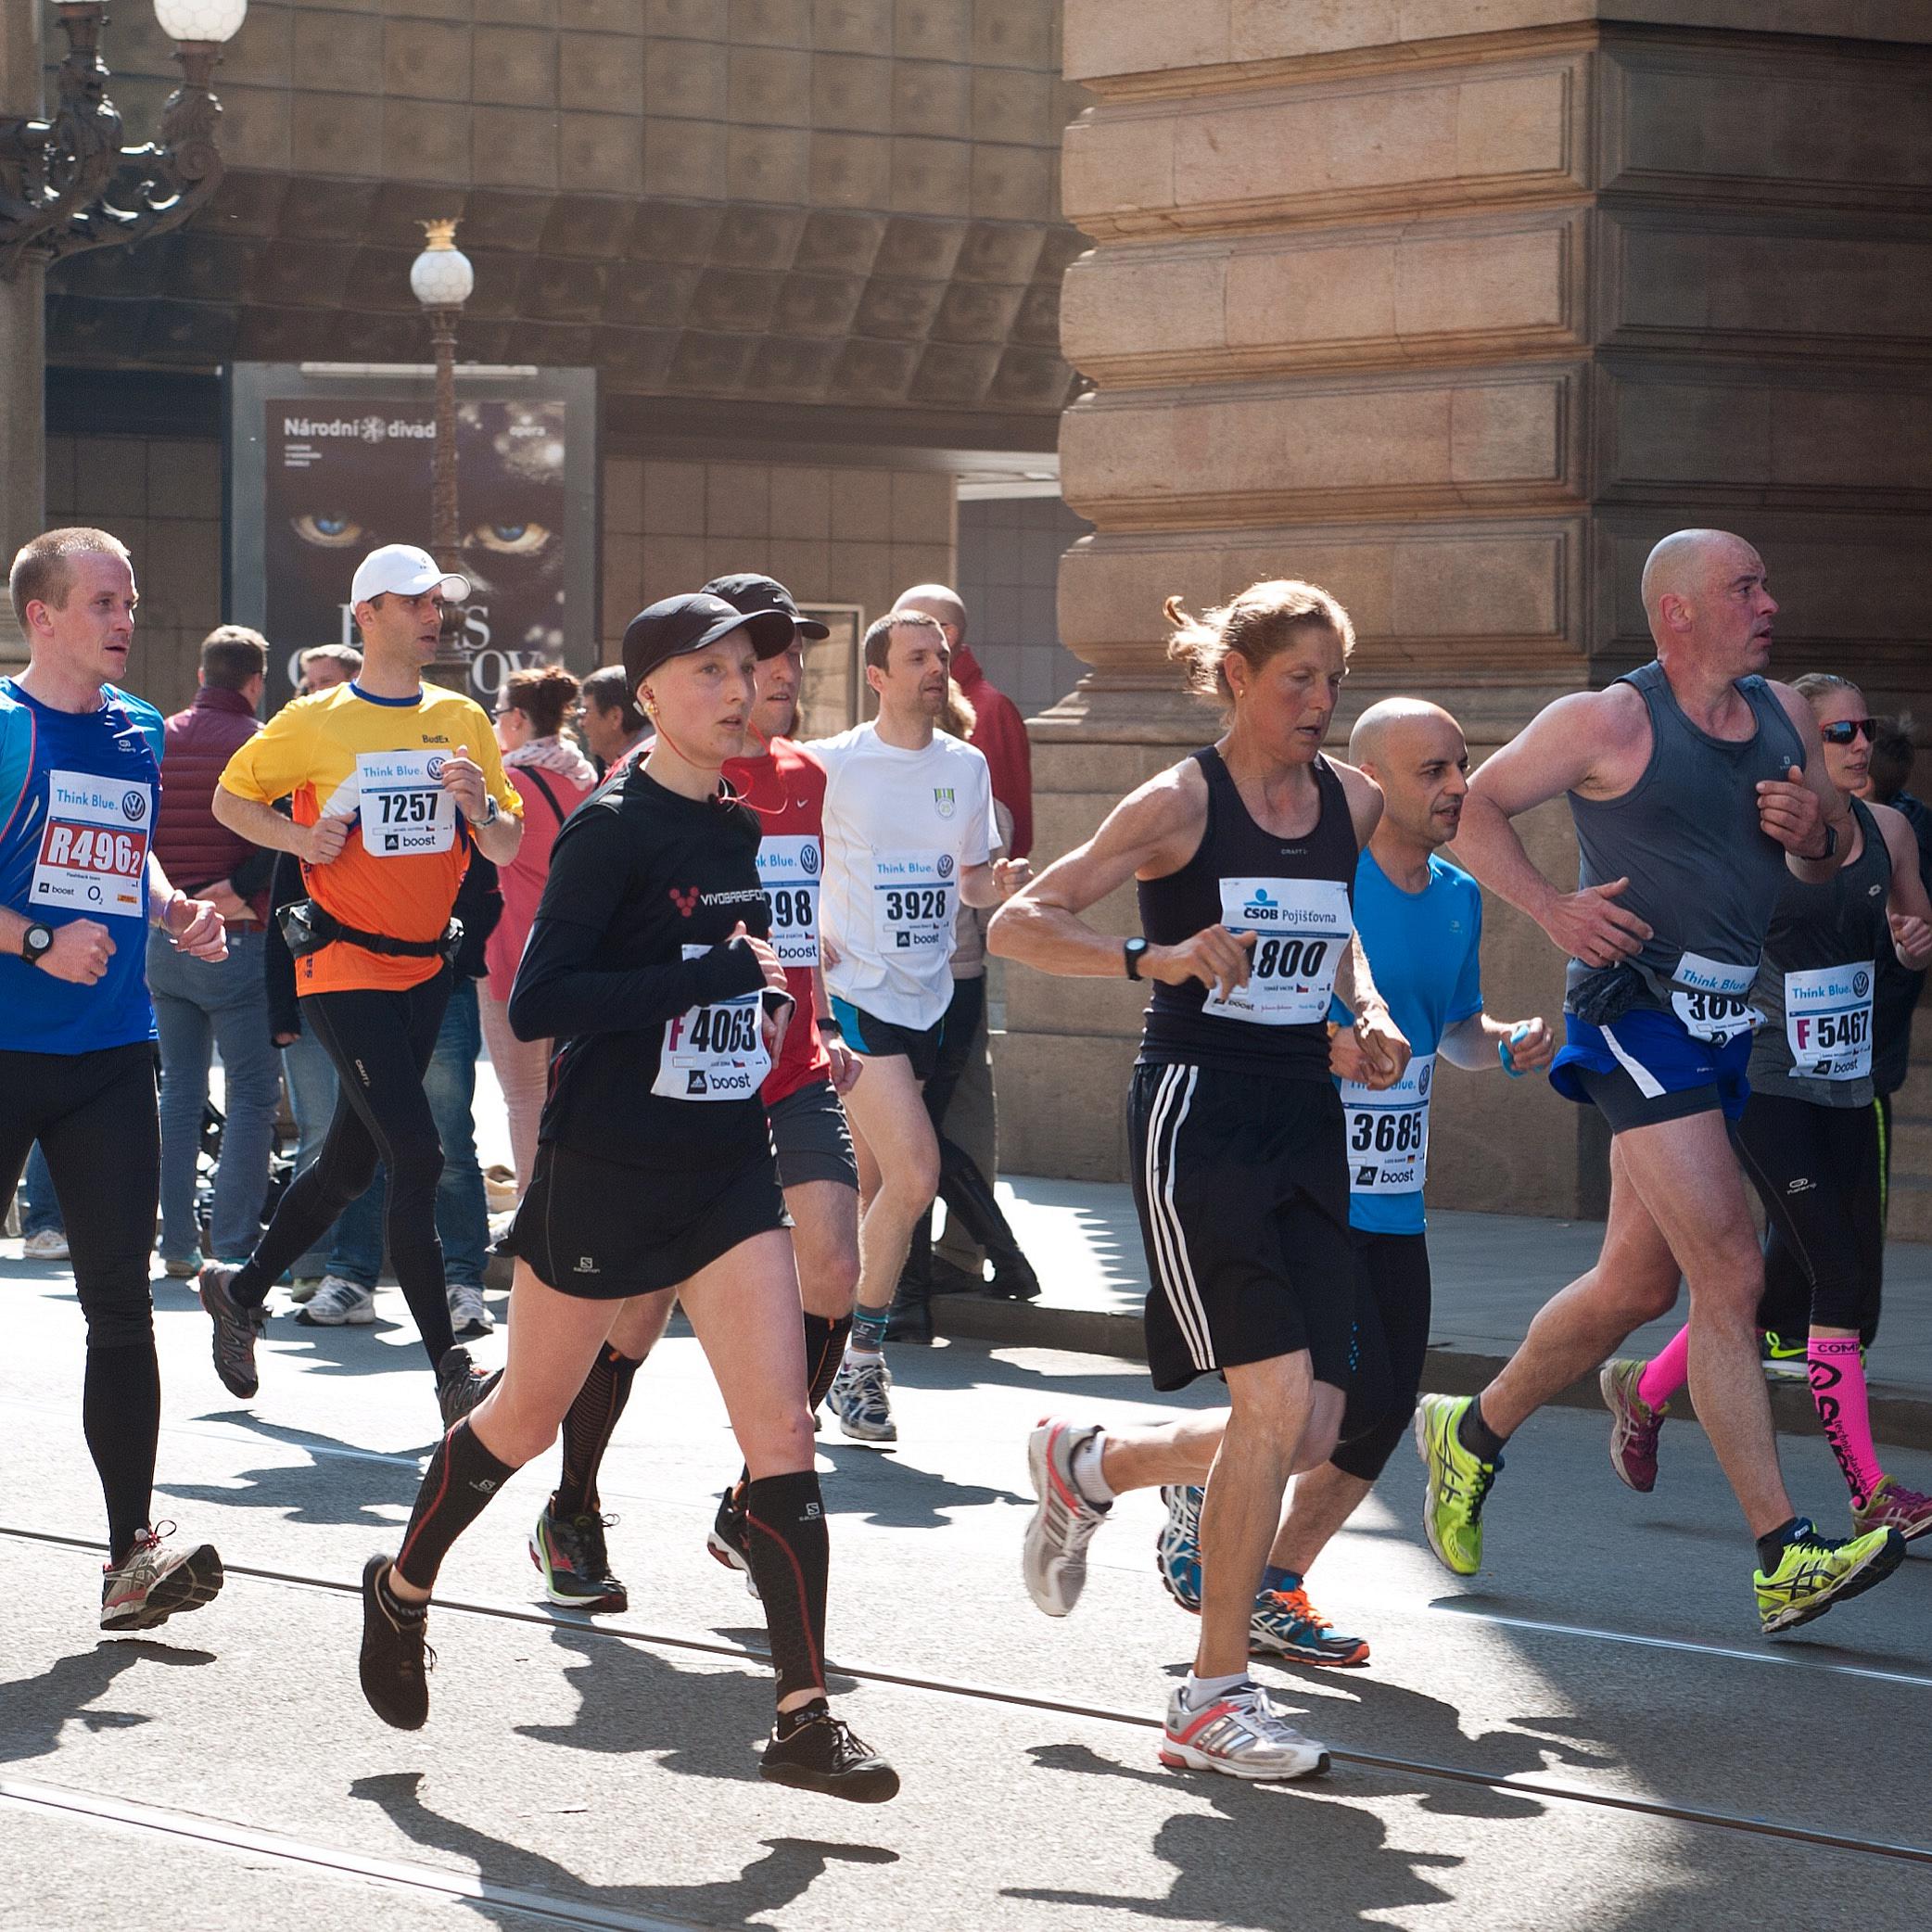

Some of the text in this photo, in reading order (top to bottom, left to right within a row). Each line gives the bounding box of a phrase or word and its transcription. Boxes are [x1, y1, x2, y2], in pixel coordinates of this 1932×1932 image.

[284, 418, 437, 439] Národní divad
[363, 766, 424, 778] Think Blue.
[57, 789, 119, 810] Think Blue.
[378, 793, 439, 824] 7257
[403, 835, 436, 847] boost
[769, 853, 797, 868] Blue.
[877, 861, 906, 874] Think
[52, 886, 75, 896] boost
[886, 890, 946, 921] 3928
[1244, 907, 1337, 925] ČSOB Pojišťovna
[913, 932, 940, 945] boost
[779, 944, 817, 959] boost
[1684, 969, 1718, 988] Think
[1792, 985, 1825, 999] Think
[690, 1007, 756, 1054] 4063
[1797, 1010, 1869, 1050] F 5467
[1834, 1059, 1858, 1074] boost
[709, 1073, 751, 1090] boost
[1352, 1111, 1422, 1152] 3685
[1380, 1168, 1414, 1183] boost
